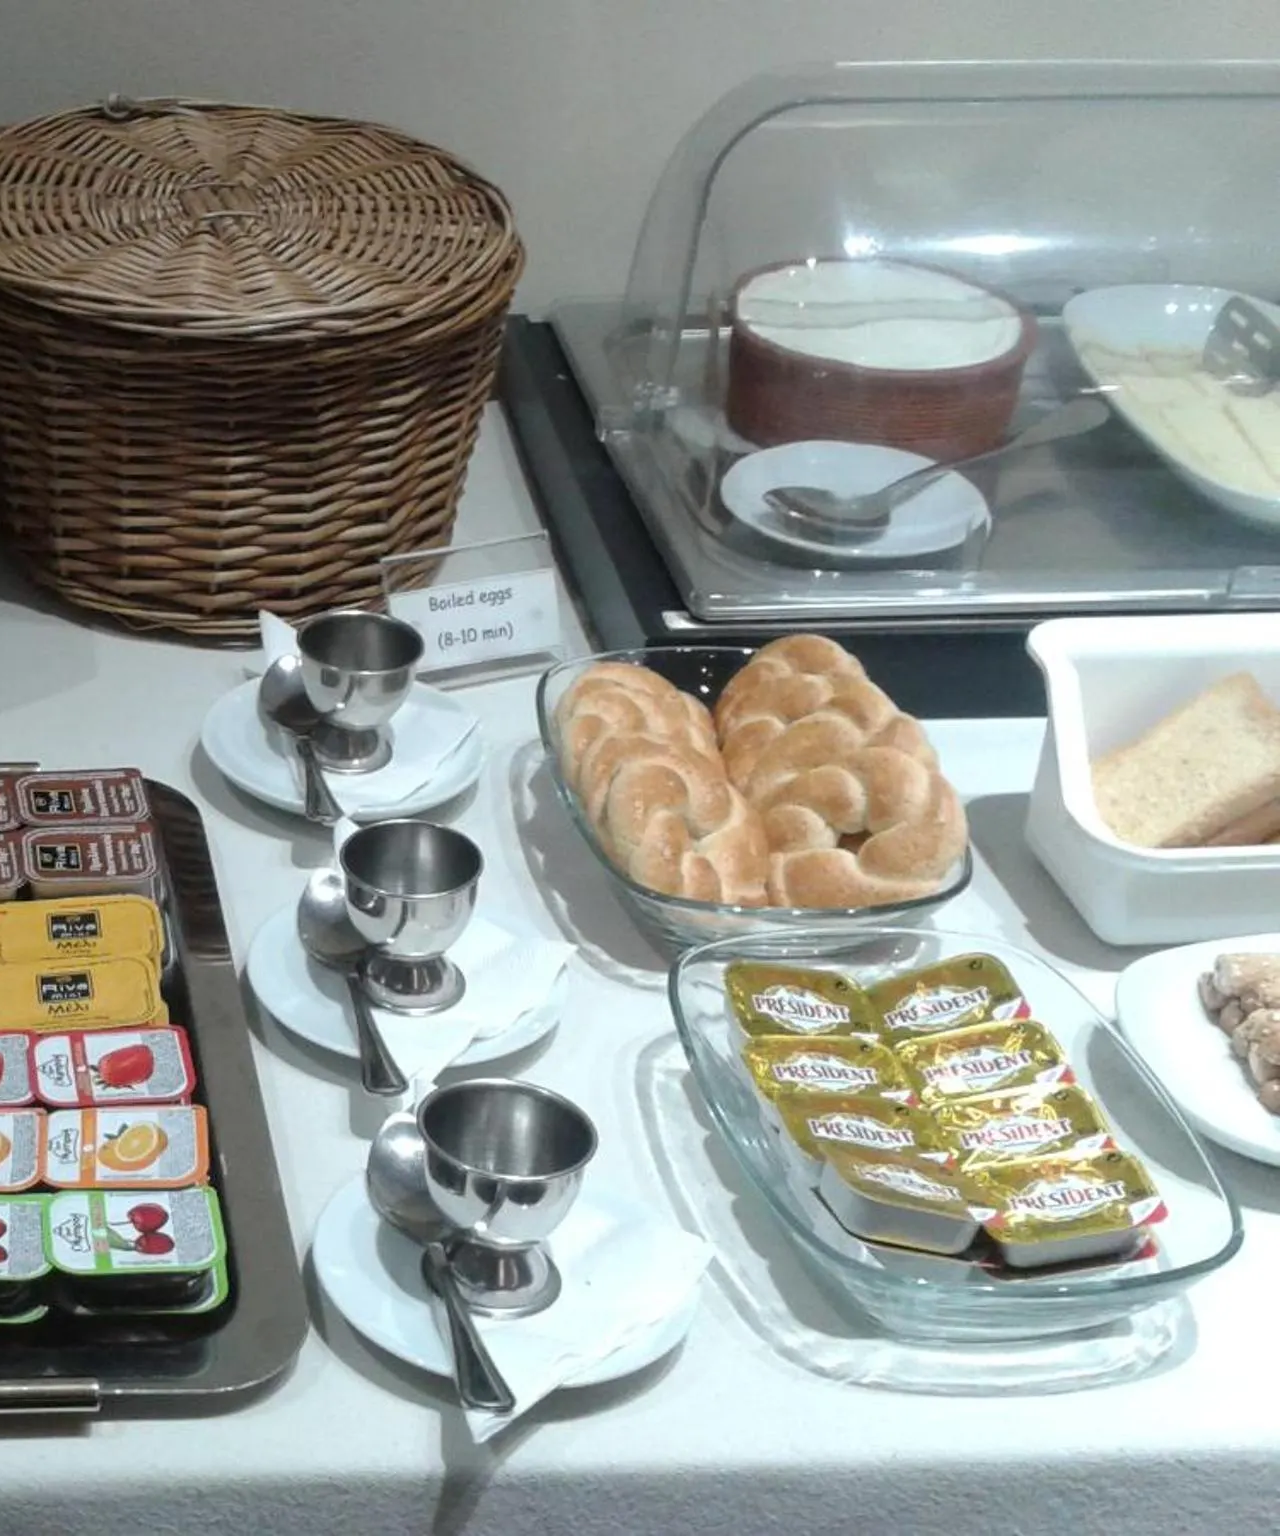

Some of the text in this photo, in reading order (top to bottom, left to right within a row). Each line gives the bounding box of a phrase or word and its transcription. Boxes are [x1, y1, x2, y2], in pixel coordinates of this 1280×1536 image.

[428, 586, 513, 612] Boiled eggs
[437, 621, 515, 651] (8-10 min)
